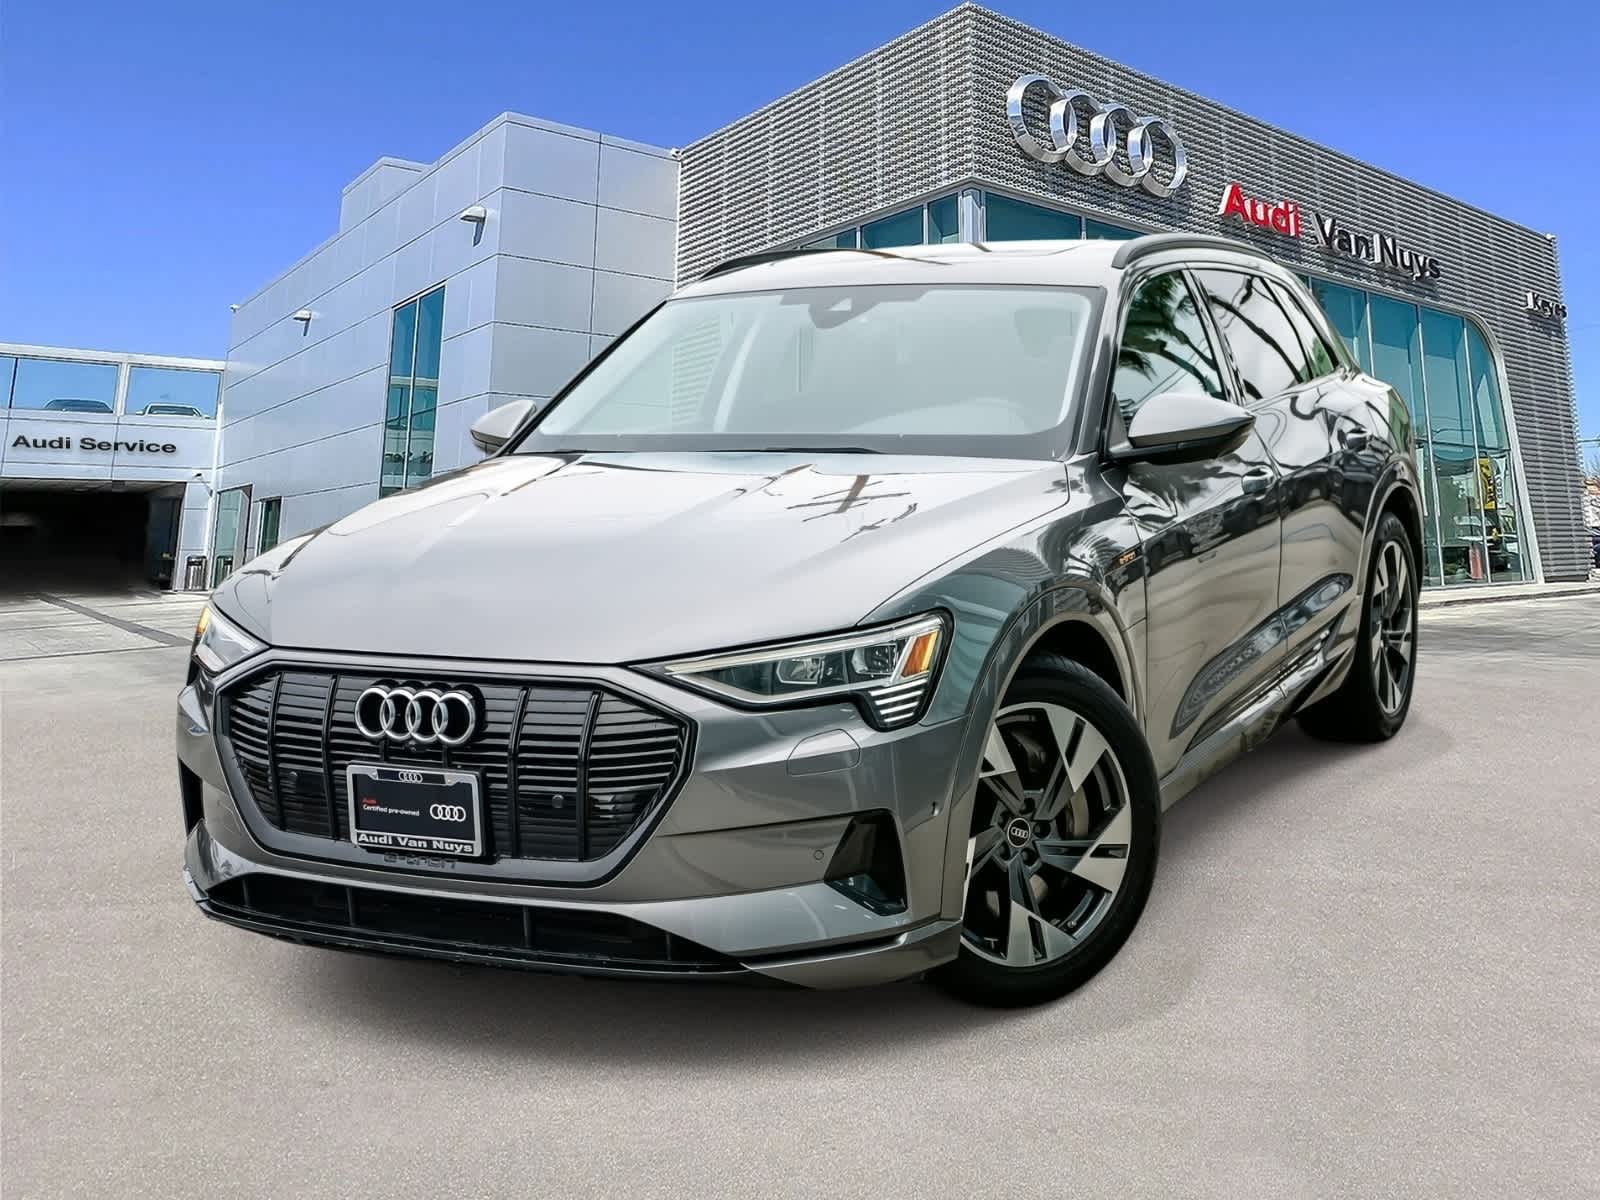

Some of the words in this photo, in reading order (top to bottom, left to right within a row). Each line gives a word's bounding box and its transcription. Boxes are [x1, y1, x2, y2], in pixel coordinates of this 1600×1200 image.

[1217, 182, 1302, 238] Audi
[1312, 211, 1371, 260] Van
[1372, 233, 1441, 281] Nuys
[1526, 292, 1567, 318] Keyes
[12, 435, 71, 449] Audi
[79, 437, 177, 453] Service
[363, 804, 388, 813] Certified
[358, 833, 393, 845] Audi
[397, 836, 428, 848] Van
[432, 840, 473, 853] Nuys
